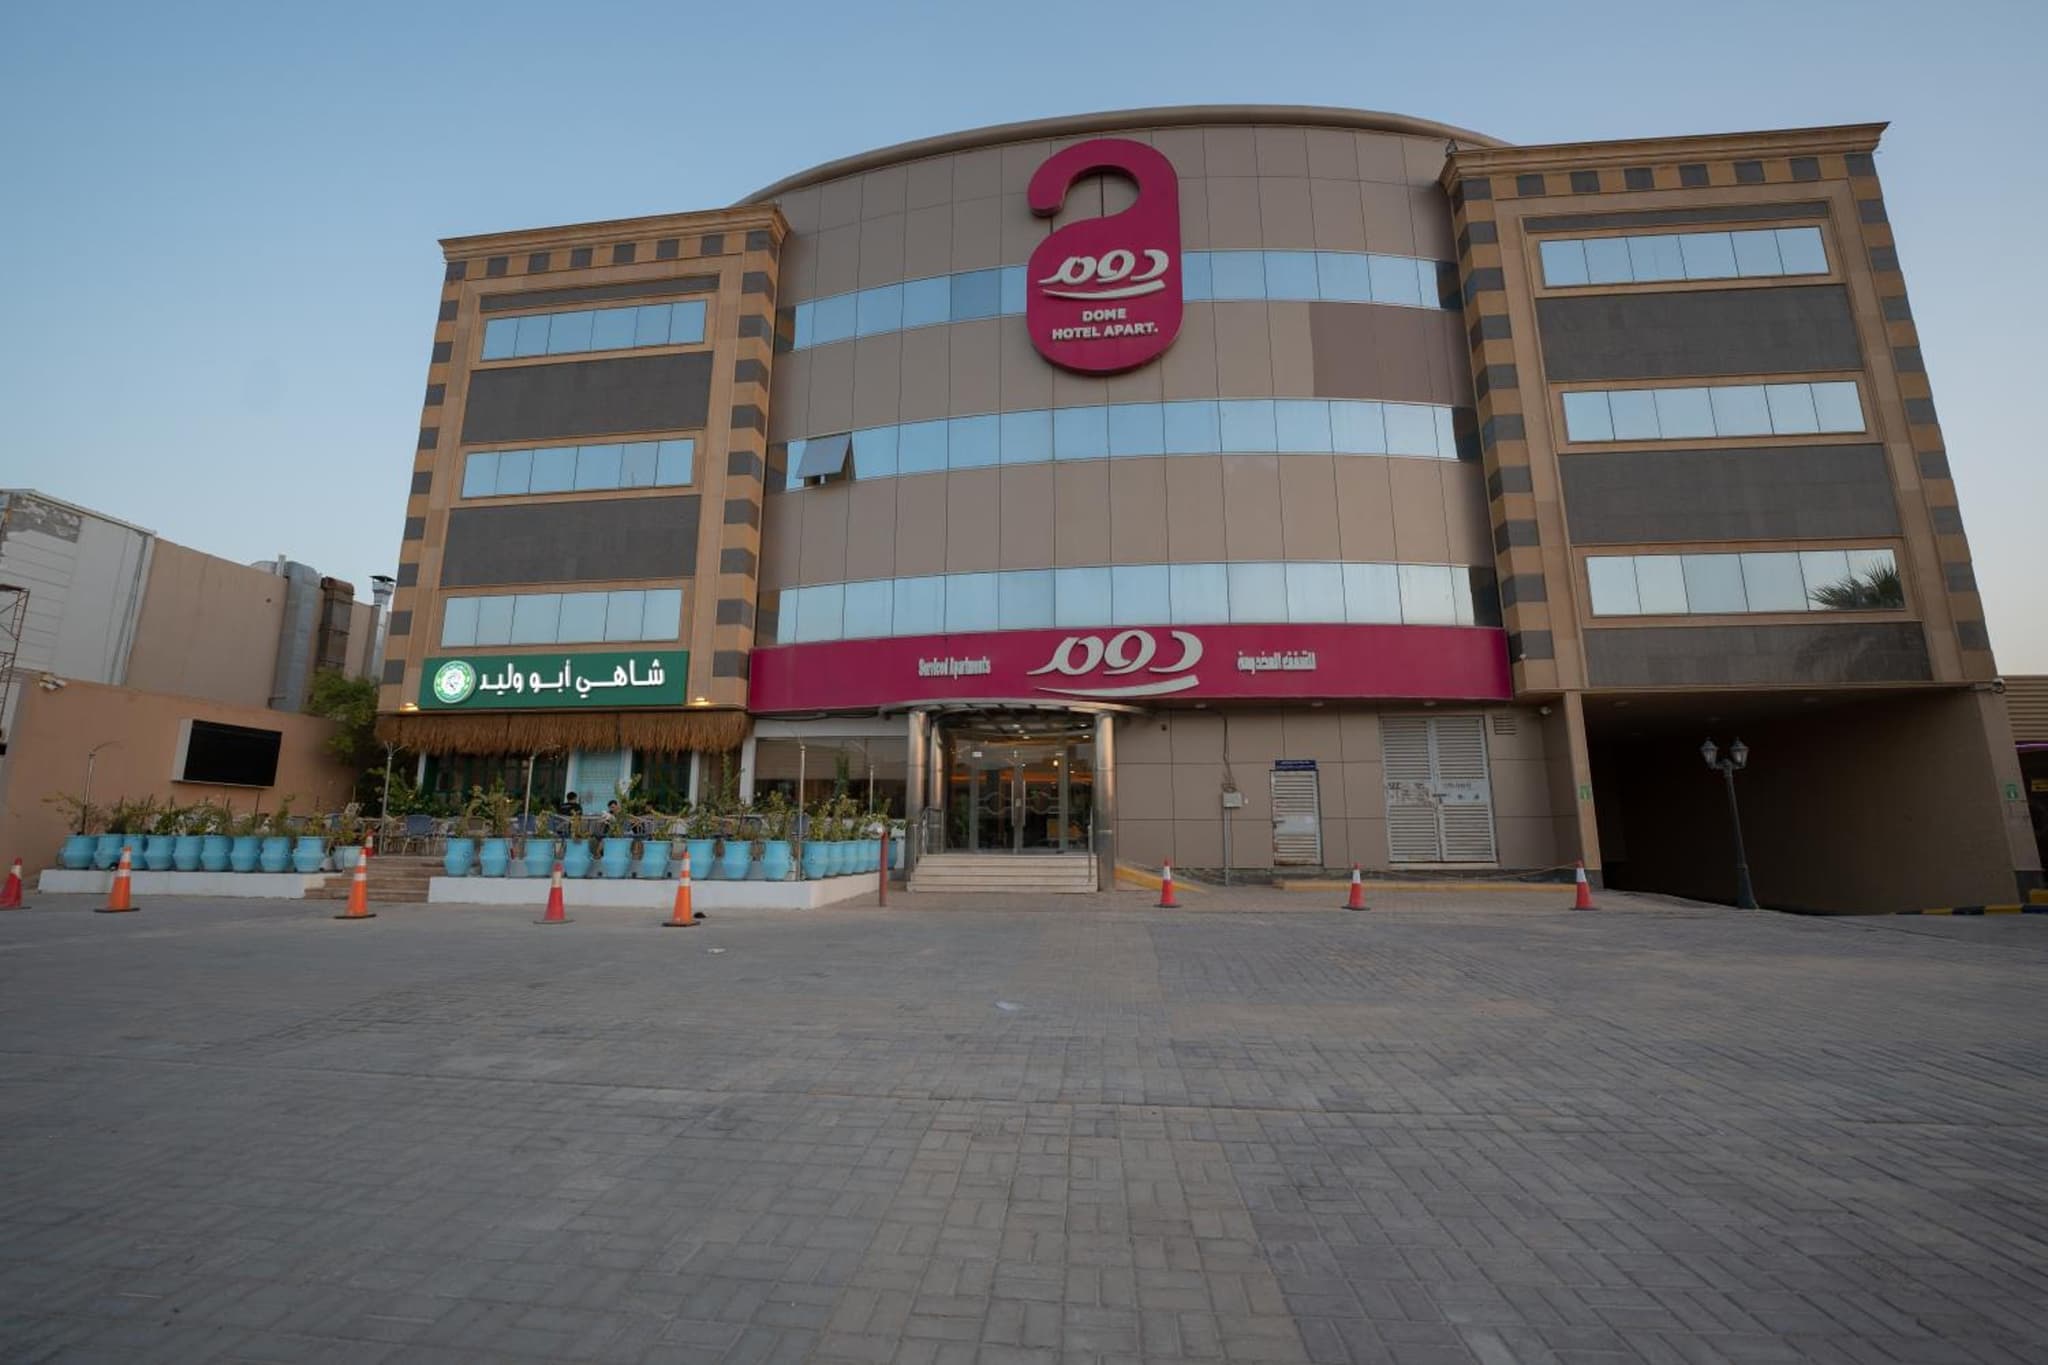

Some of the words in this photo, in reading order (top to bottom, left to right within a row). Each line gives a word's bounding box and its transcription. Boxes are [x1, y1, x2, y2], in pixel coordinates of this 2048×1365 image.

[1037, 249, 1169, 285] دوم
[1052, 326, 1101, 340] HOTEL
[1104, 322, 1159, 337] APART.
[1082, 308, 1127, 322] DOME
[1026, 630, 1204, 676] دوم
[479, 662, 524, 696] وليد
[529, 659, 571, 694] أبو
[575, 658, 666, 699] شاهي
